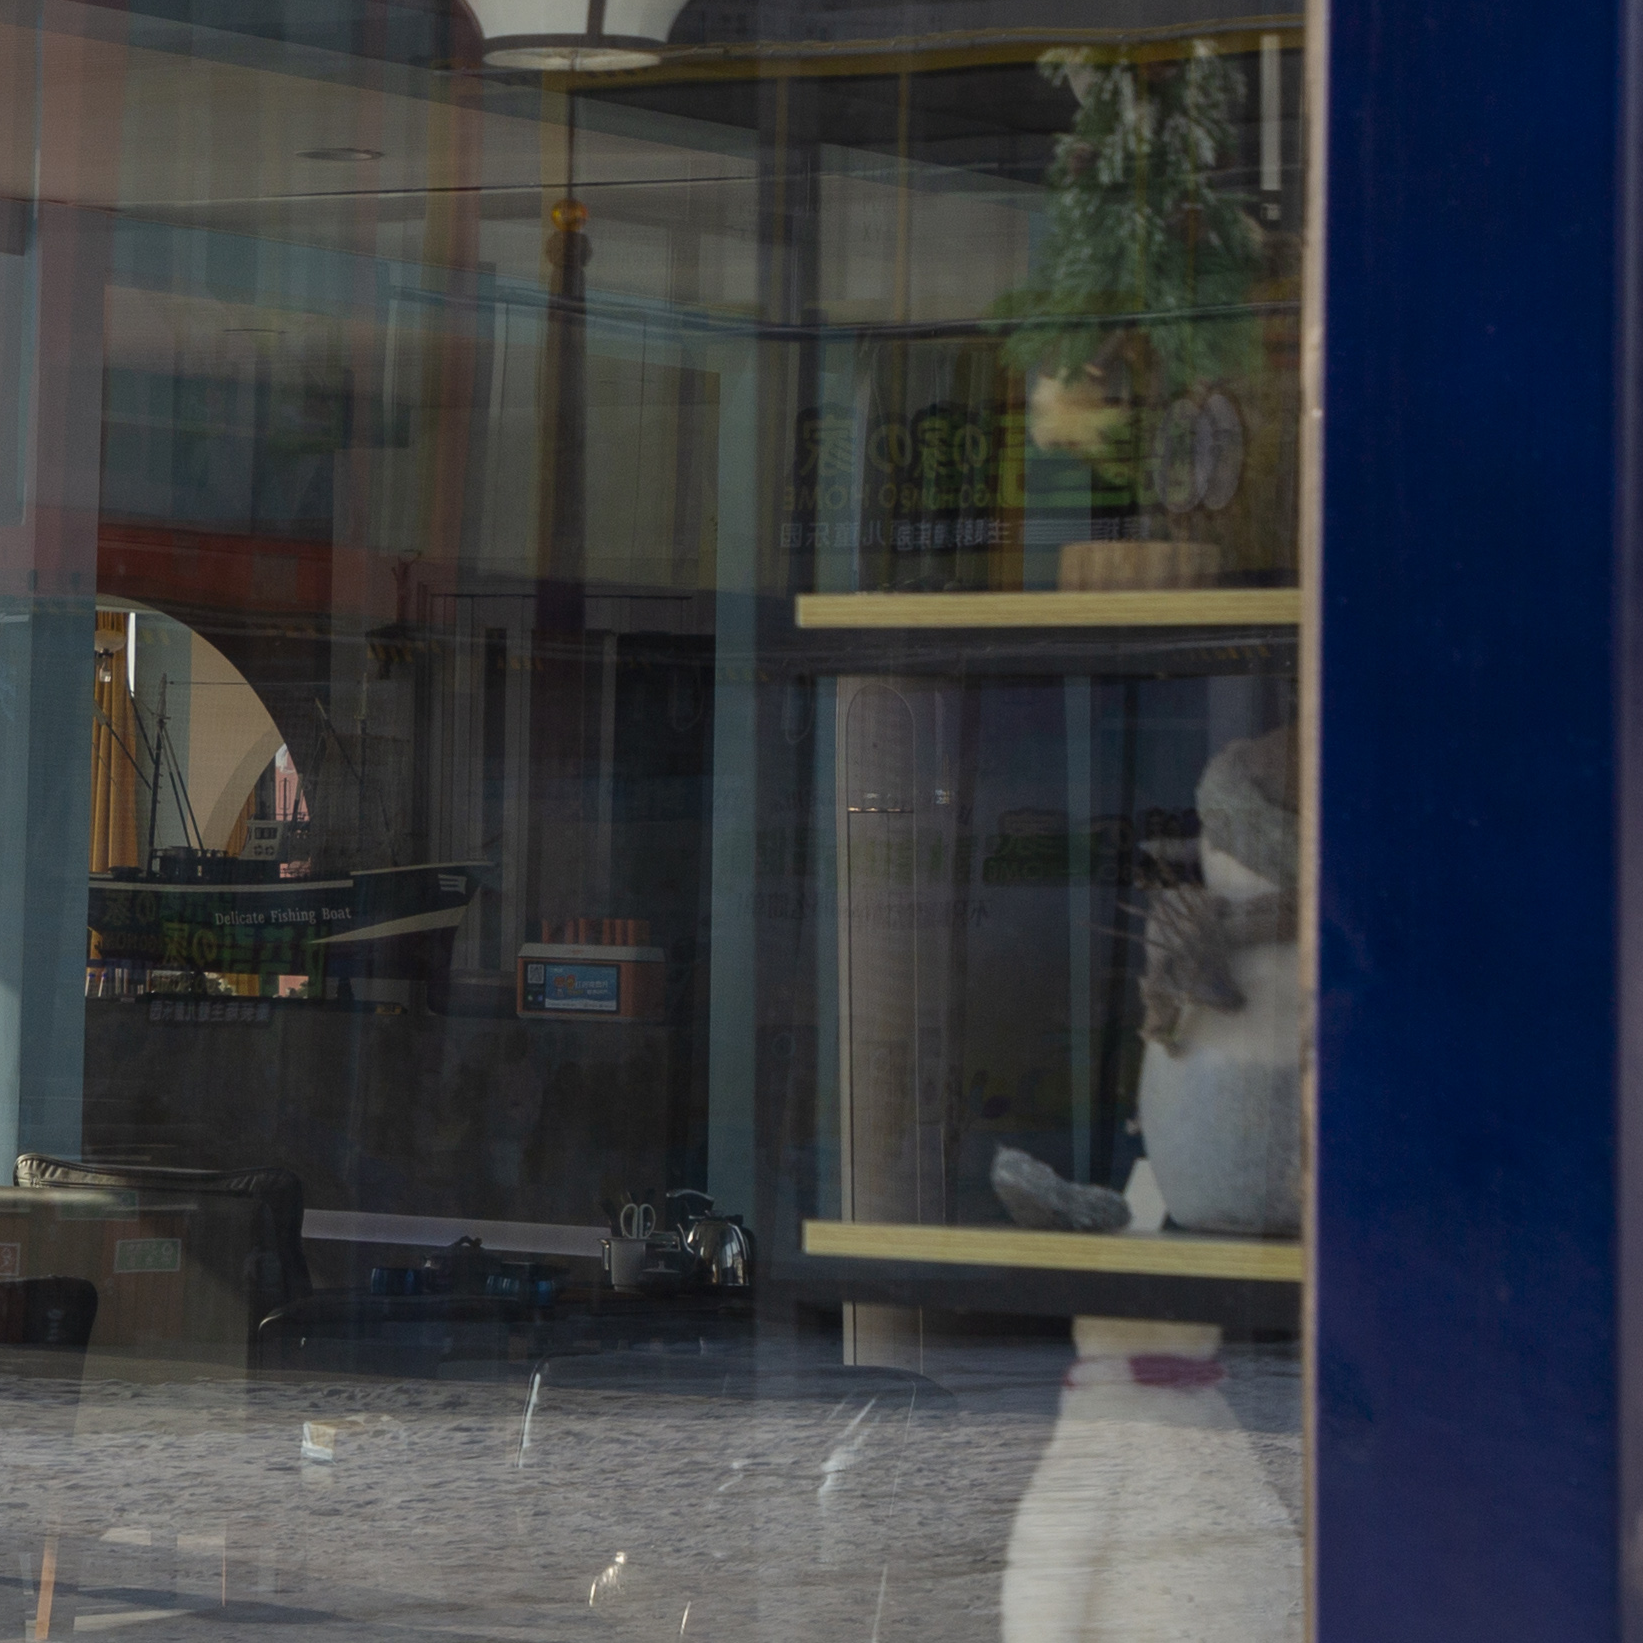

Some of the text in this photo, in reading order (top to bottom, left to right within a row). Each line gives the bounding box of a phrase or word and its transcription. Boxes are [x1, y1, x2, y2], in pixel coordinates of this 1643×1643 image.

[214, 906, 353, 926] Delicate Fishing Boat
